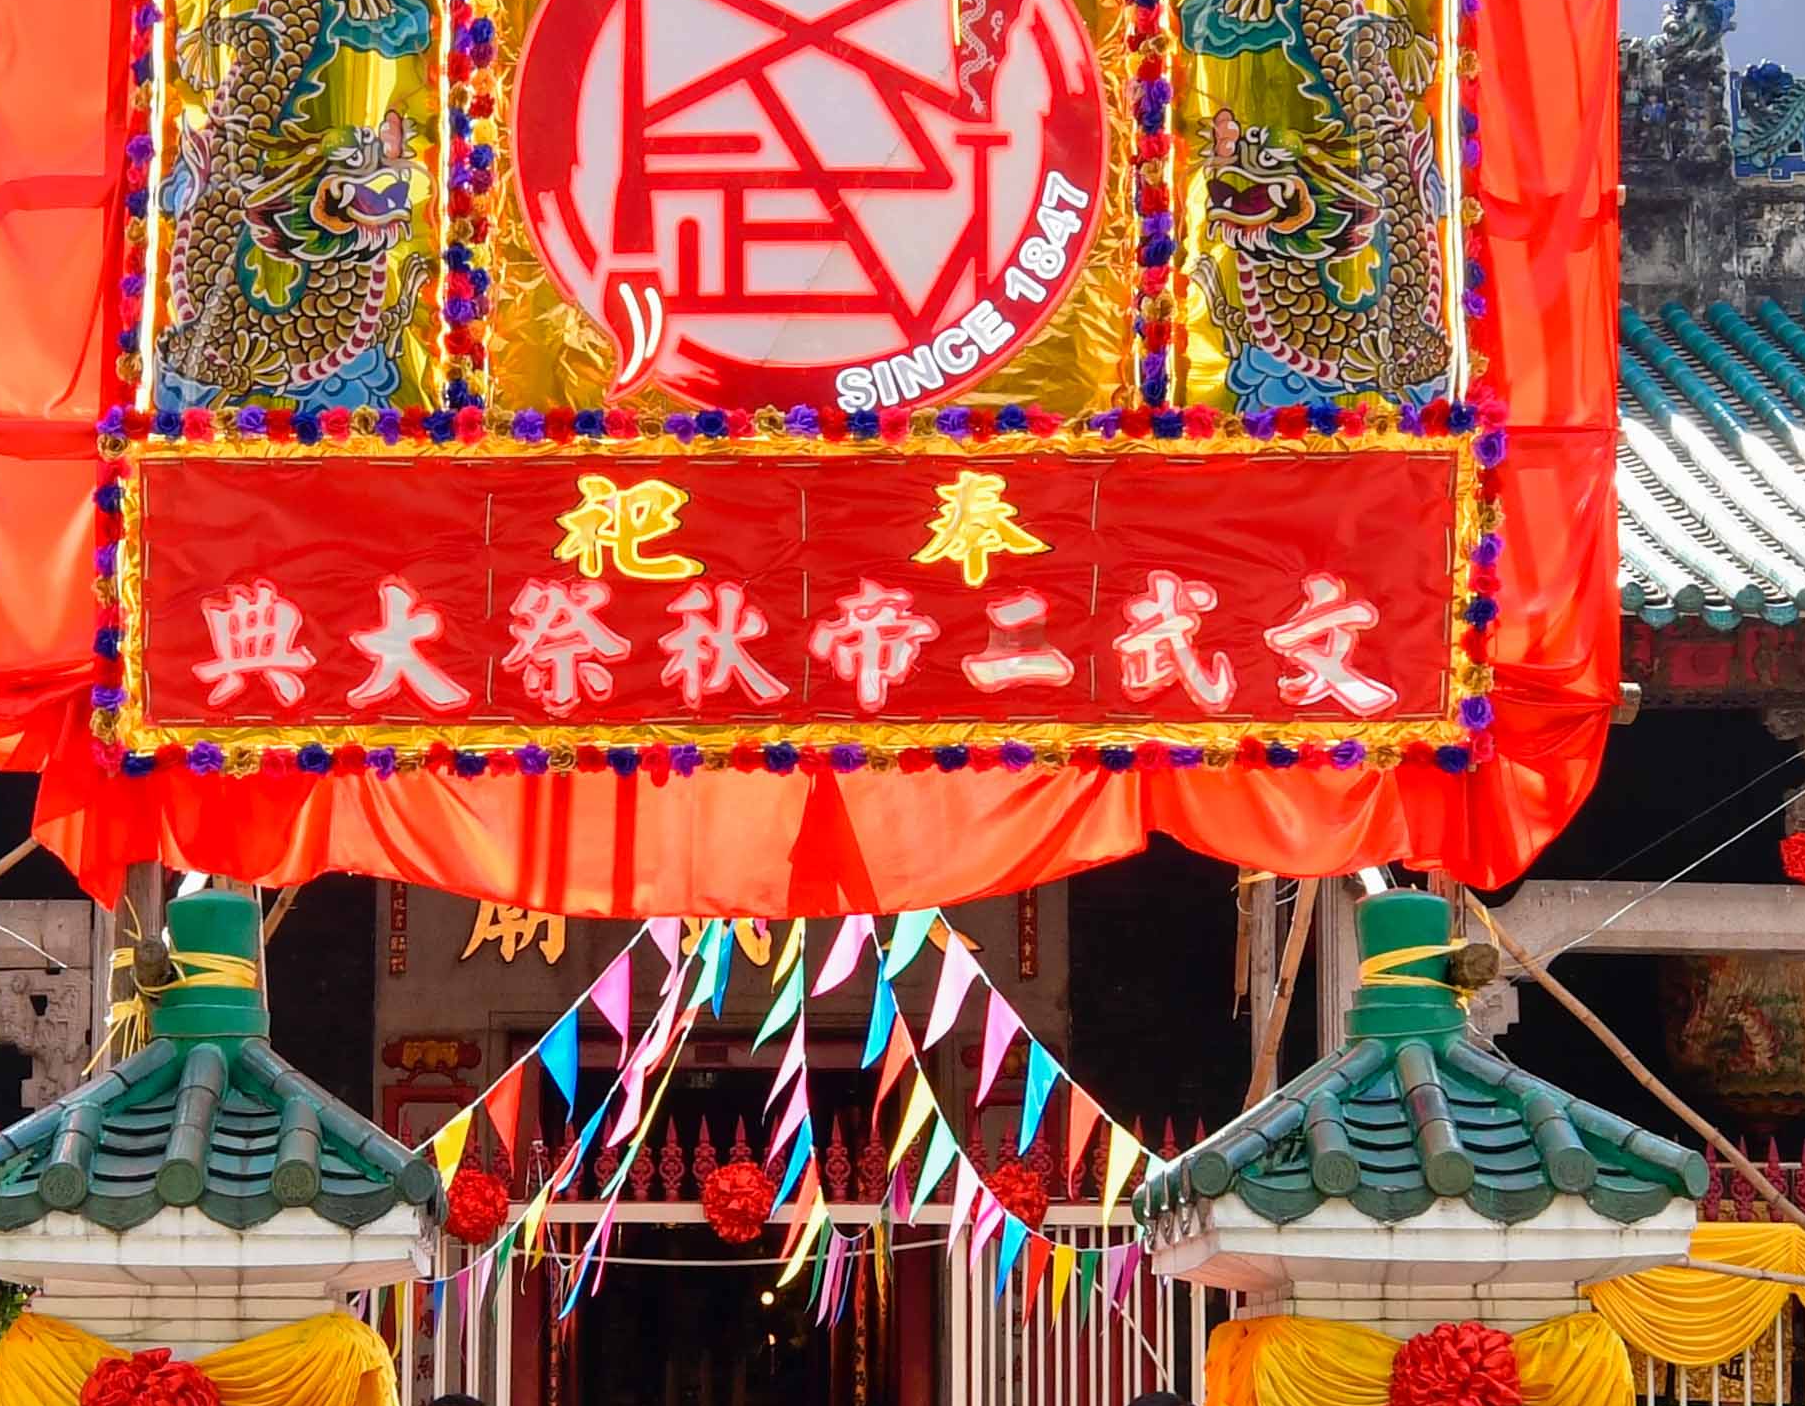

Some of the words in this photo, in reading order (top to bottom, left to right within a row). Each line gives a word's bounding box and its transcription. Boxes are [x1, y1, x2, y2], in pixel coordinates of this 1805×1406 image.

[835, 300, 1016, 412] SINCE
[1003, 170, 1089, 304] 1847
[555, 472, 1047, 585] 奉祀
[196, 570, 1399, 714] 文武二帝秋祭大典
